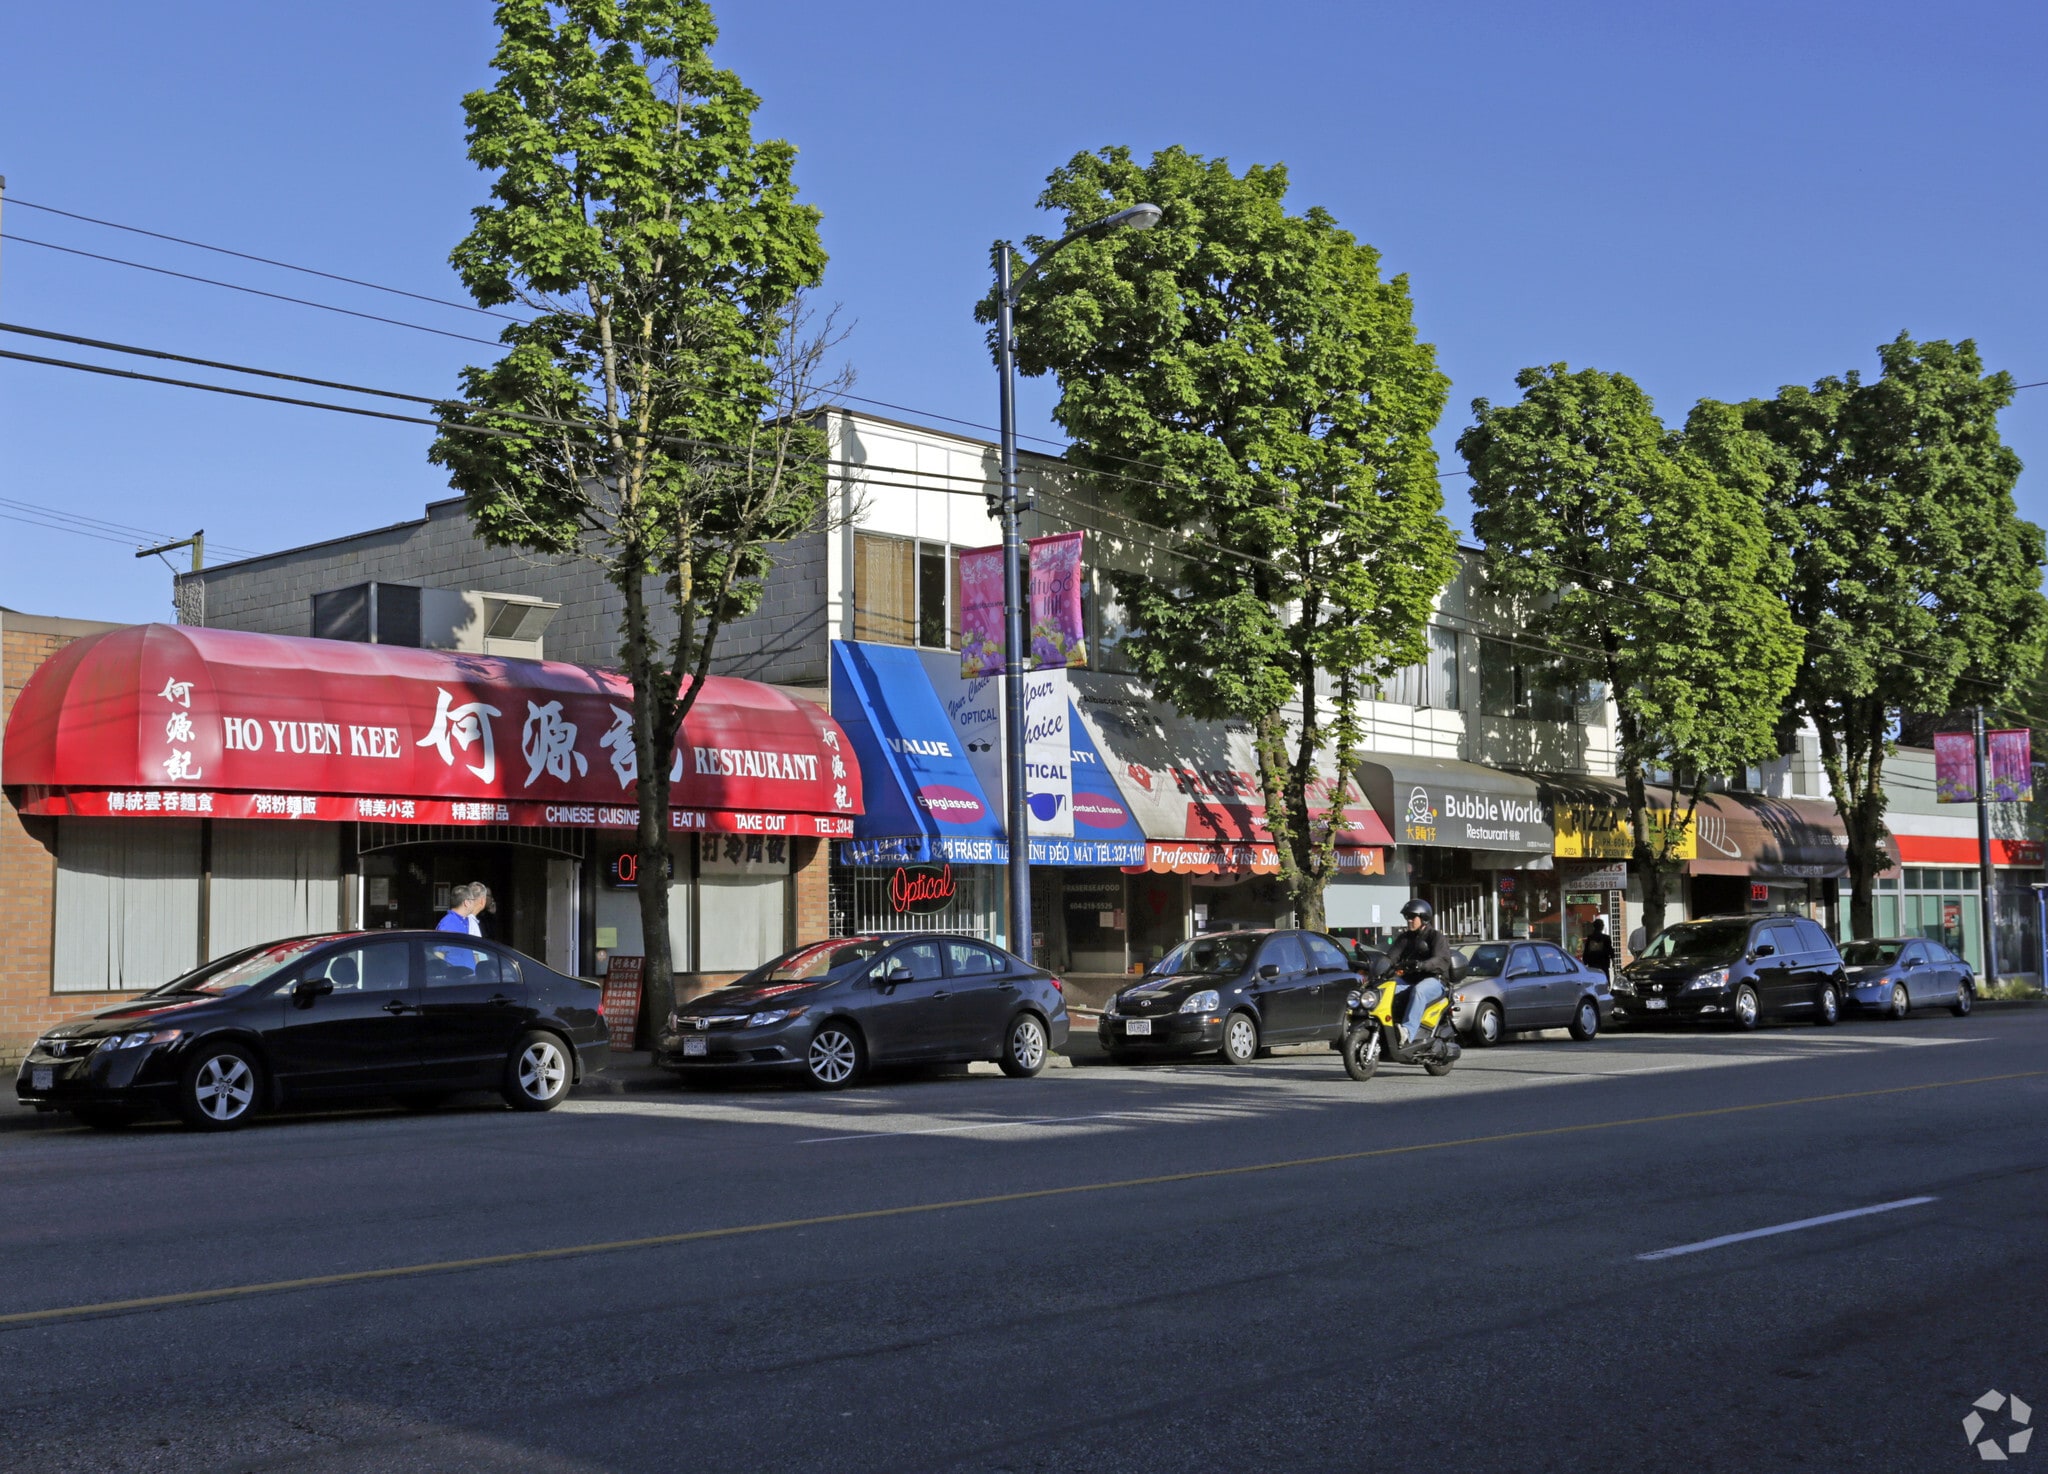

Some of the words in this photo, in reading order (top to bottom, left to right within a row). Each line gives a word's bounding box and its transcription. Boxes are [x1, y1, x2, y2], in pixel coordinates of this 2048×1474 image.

[960, 708, 998, 726] OPTICAL
[157, 676, 202, 782] 何源記
[223, 716, 264, 751] HO
[268, 720, 342, 755] YUEN
[348, 725, 401, 758] KEE
[1024, 714, 1064, 745] hoice
[886, 737, 953, 758] VALUE
[693, 746, 819, 781] RESTAURANT
[822, 727, 853, 809] 何源記
[1026, 763, 1068, 780] TICAL
[1168, 767, 1264, 797] FRASER
[358, 799, 416, 818] 精美小菜
[451, 803, 510, 821] 精選甜品
[917, 796, 979, 811] Eyeglasses
[1096, 805, 1123, 815] Lenses
[1445, 794, 1498, 821] Bubble
[545, 805, 596, 823] CHINESE
[598, 807, 641, 826] CUISINE
[672, 811, 694, 828] EAT
[695, 812, 706, 828] IN
[735, 814, 763, 830] TAKE
[765, 815, 787, 831] OUT
[1571, 808, 1619, 832] PIZZA
[814, 818, 835, 834] TEL:
[1466, 823, 1508, 842] Restaurant
[872, 853, 915, 863] OPTICAL
[954, 841, 993, 861] FRASER
[1152, 845, 1228, 868] Professional
[1260, 848, 1280, 866] Sto
[892, 863, 957, 913] Optical
